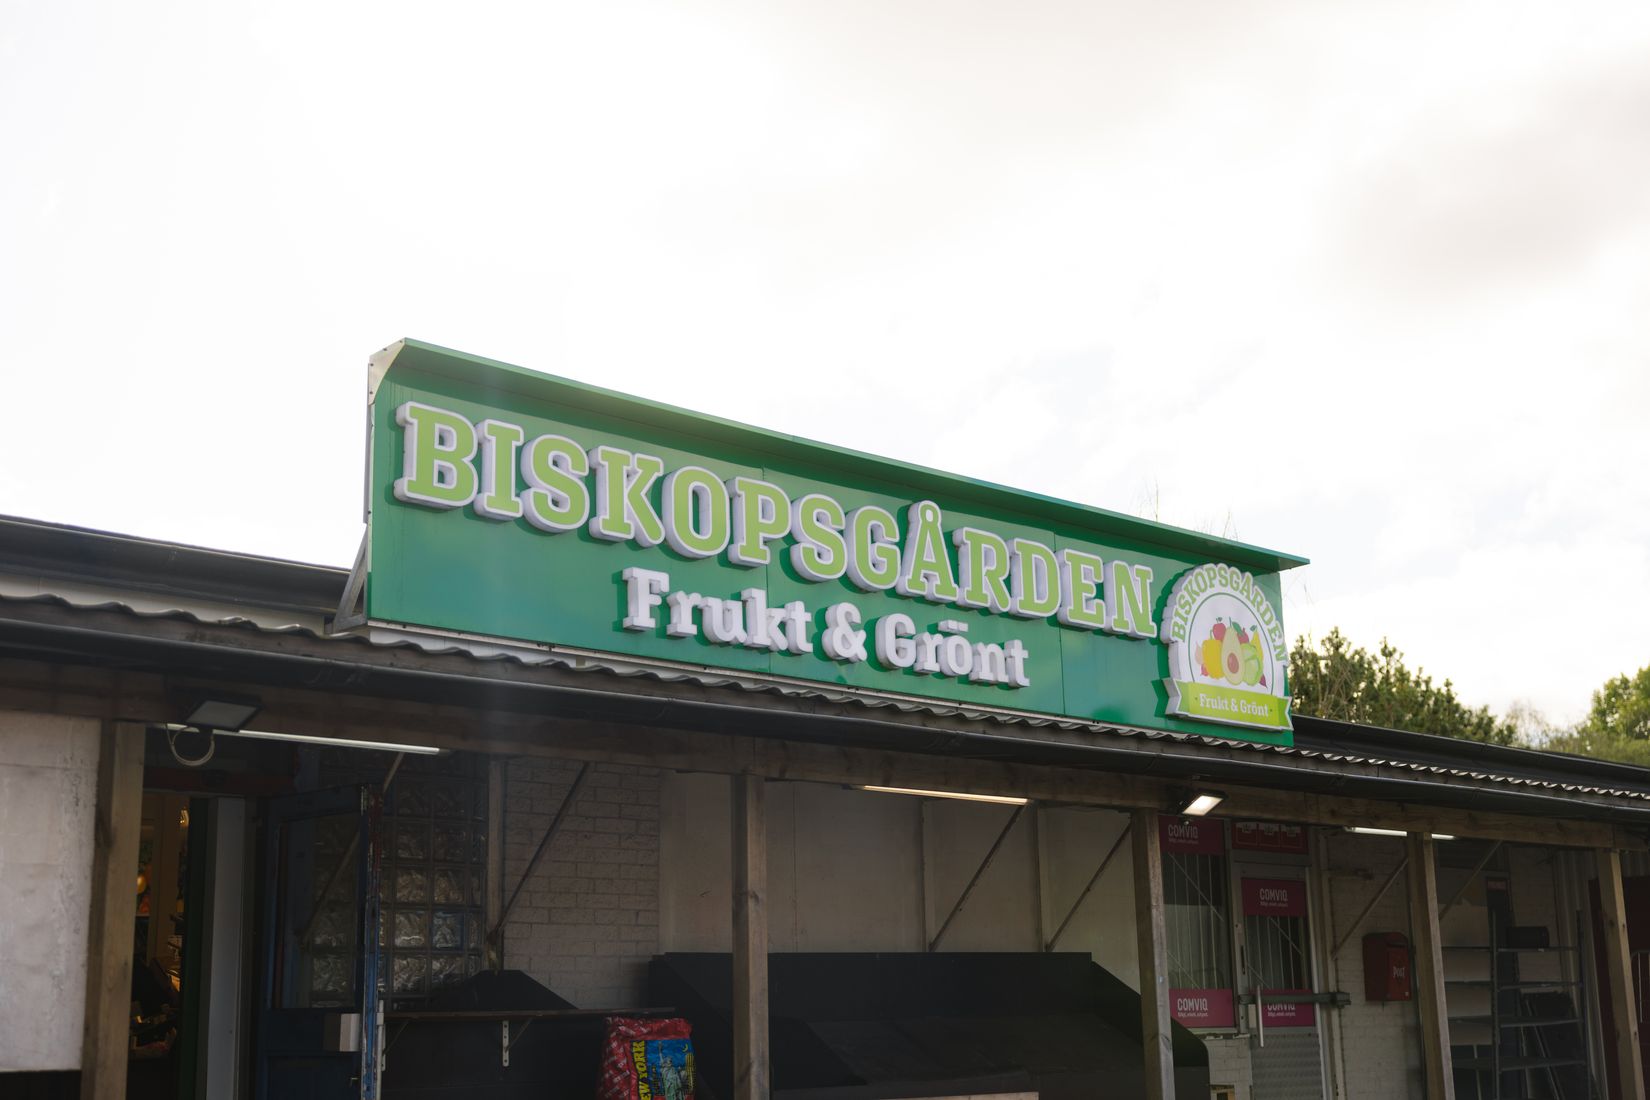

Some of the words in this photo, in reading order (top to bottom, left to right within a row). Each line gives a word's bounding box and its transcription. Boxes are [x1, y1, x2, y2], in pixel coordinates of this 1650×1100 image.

[394, 401, 1158, 640] BISKOPSGÅRDEN
[622, 567, 813, 654] Frukt
[822, 602, 868, 663] &
[875, 613, 1030, 688] Grönt
[1199, 693, 1229, 711] Frukt
[1231, 698, 1238, 713] &
[1240, 700, 1269, 718] Grönt
[1168, 824, 1198, 838] COMVIQ
[1259, 888, 1288, 902] COMVIQ
[1177, 998, 1208, 1011] COMVIQ
[633, 1040, 647, 1079] YORK
